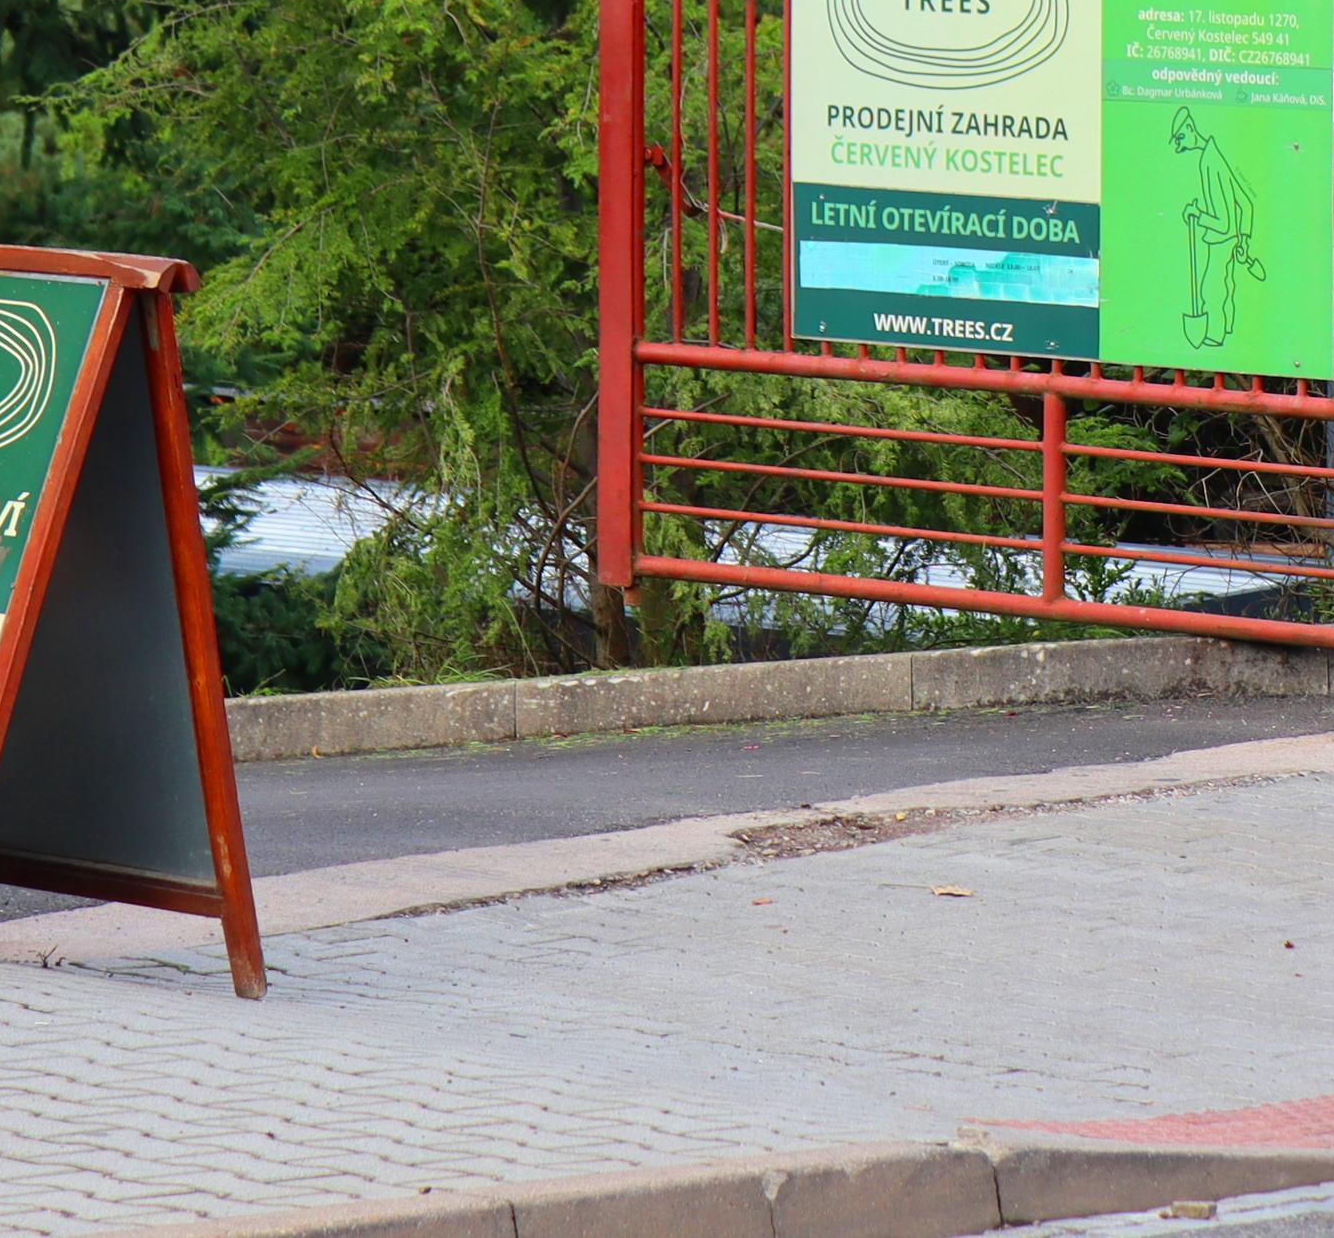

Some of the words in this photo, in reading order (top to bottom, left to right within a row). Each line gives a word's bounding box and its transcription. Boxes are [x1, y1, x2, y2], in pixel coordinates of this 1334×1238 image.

[1138, 8, 1184, 23] adresa:
[1189, 10, 1205, 23] 17.
[1209, 11, 1264, 27] listopadu
[1269, 14, 1299, 29] 1270,
[1146, 25, 1195, 44] Červený
[1198, 30, 1248, 45] Kostelec
[1252, 32, 1273, 46] 549
[1276, 33, 1289, 46] 41
[1127, 43, 1143, 58] IČ:
[1147, 45, 1204, 61] 26768941,
[1209, 46, 1236, 63] DIČ:
[1239, 49, 1310, 66] CZ26768941
[1152, 67, 1222, 86] odpovědný
[1225, 71, 1279, 86] vedoucí:
[1137, 86, 1172, 100] Dagmar
[1174, 87, 1222, 100] Urbánková
[1251, 92, 1270, 104] Jana
[827, 104, 944, 138] PRODEJNÍ
[950, 111, 1069, 141] ZAHRADA
[830, 134, 938, 170] ČERVENÝ
[945, 148, 1064, 178] KOSTELEC
[811, 200, 877, 229] LETNÍ
[881, 205, 1007, 238] OTEVÍRACÍ
[1011, 216, 1081, 244] DOBA
[874, 313, 1013, 341] WWW.TREES.CZ
